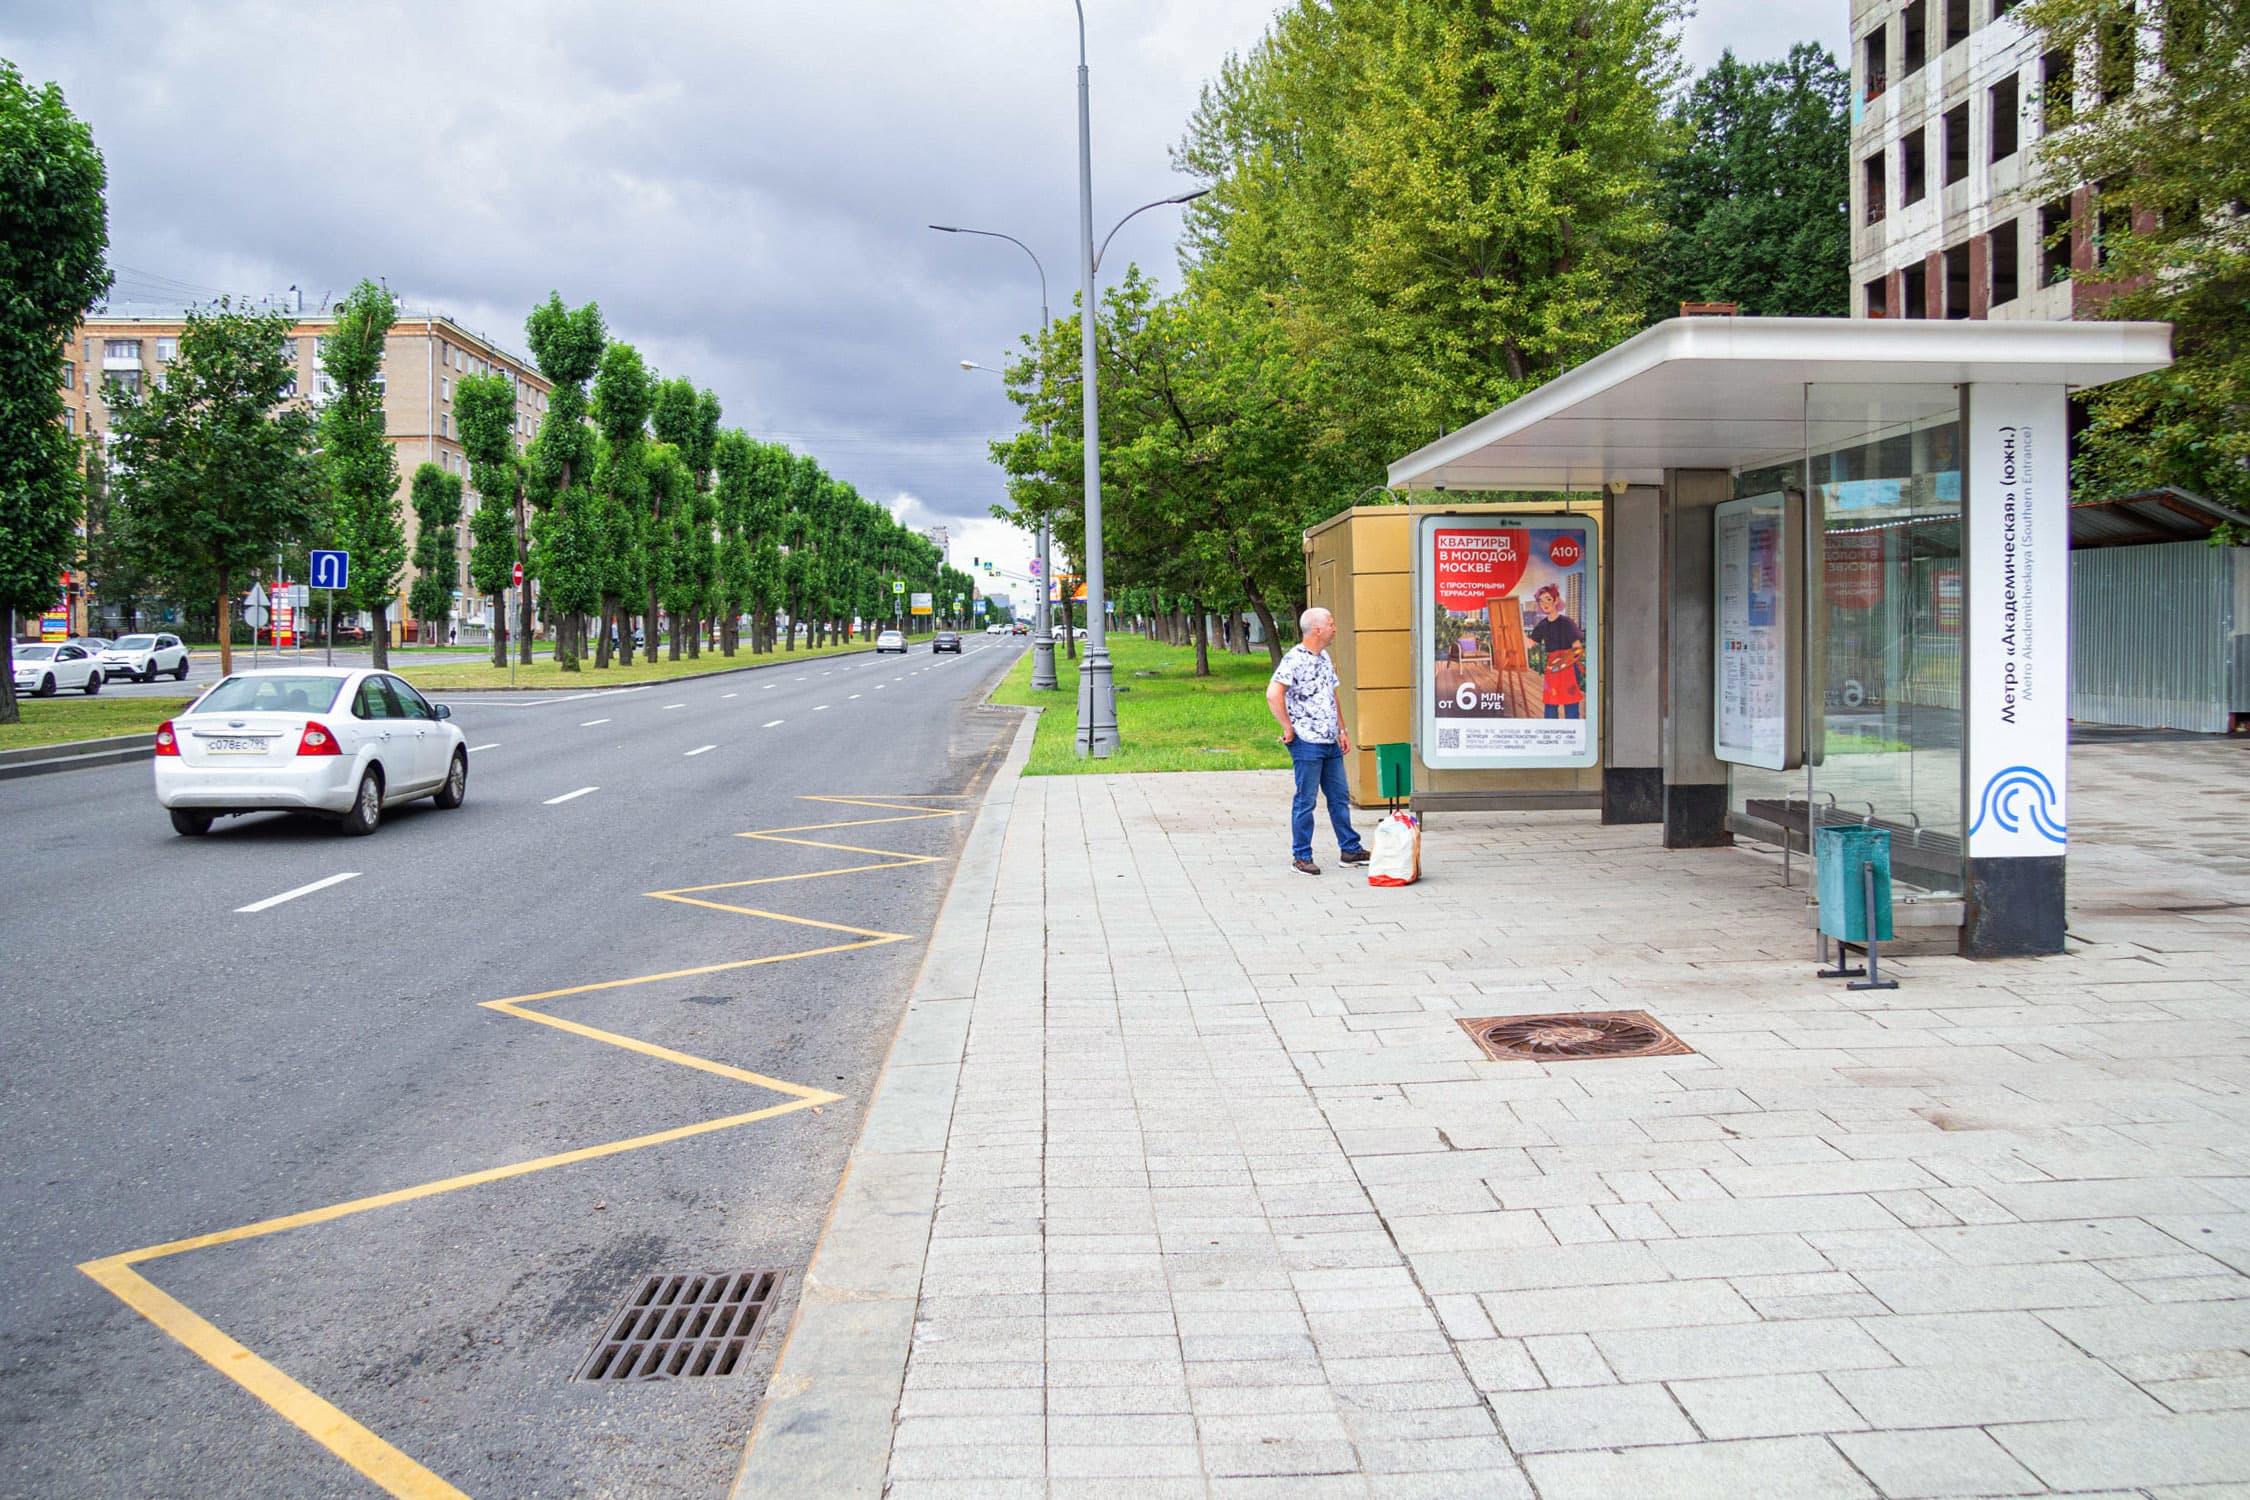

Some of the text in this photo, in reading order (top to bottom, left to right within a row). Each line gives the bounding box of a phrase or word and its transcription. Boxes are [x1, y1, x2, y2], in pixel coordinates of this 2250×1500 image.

[1439, 537, 1509, 548] КВАРТИРЫ
[1439, 549, 1517, 563] В МОЛОДОЙ
[1439, 562, 1493, 573] МОСКВЕ
[2020, 426, 2035, 701] Metro Akademicheskaya (Southern Entrance)
[1999, 426, 2018, 724] Метро «Академическая» (южн.)
[1446, 582, 1505, 590] ПРОСТОРНЫМИ
[1455, 681, 1478, 711] 6
